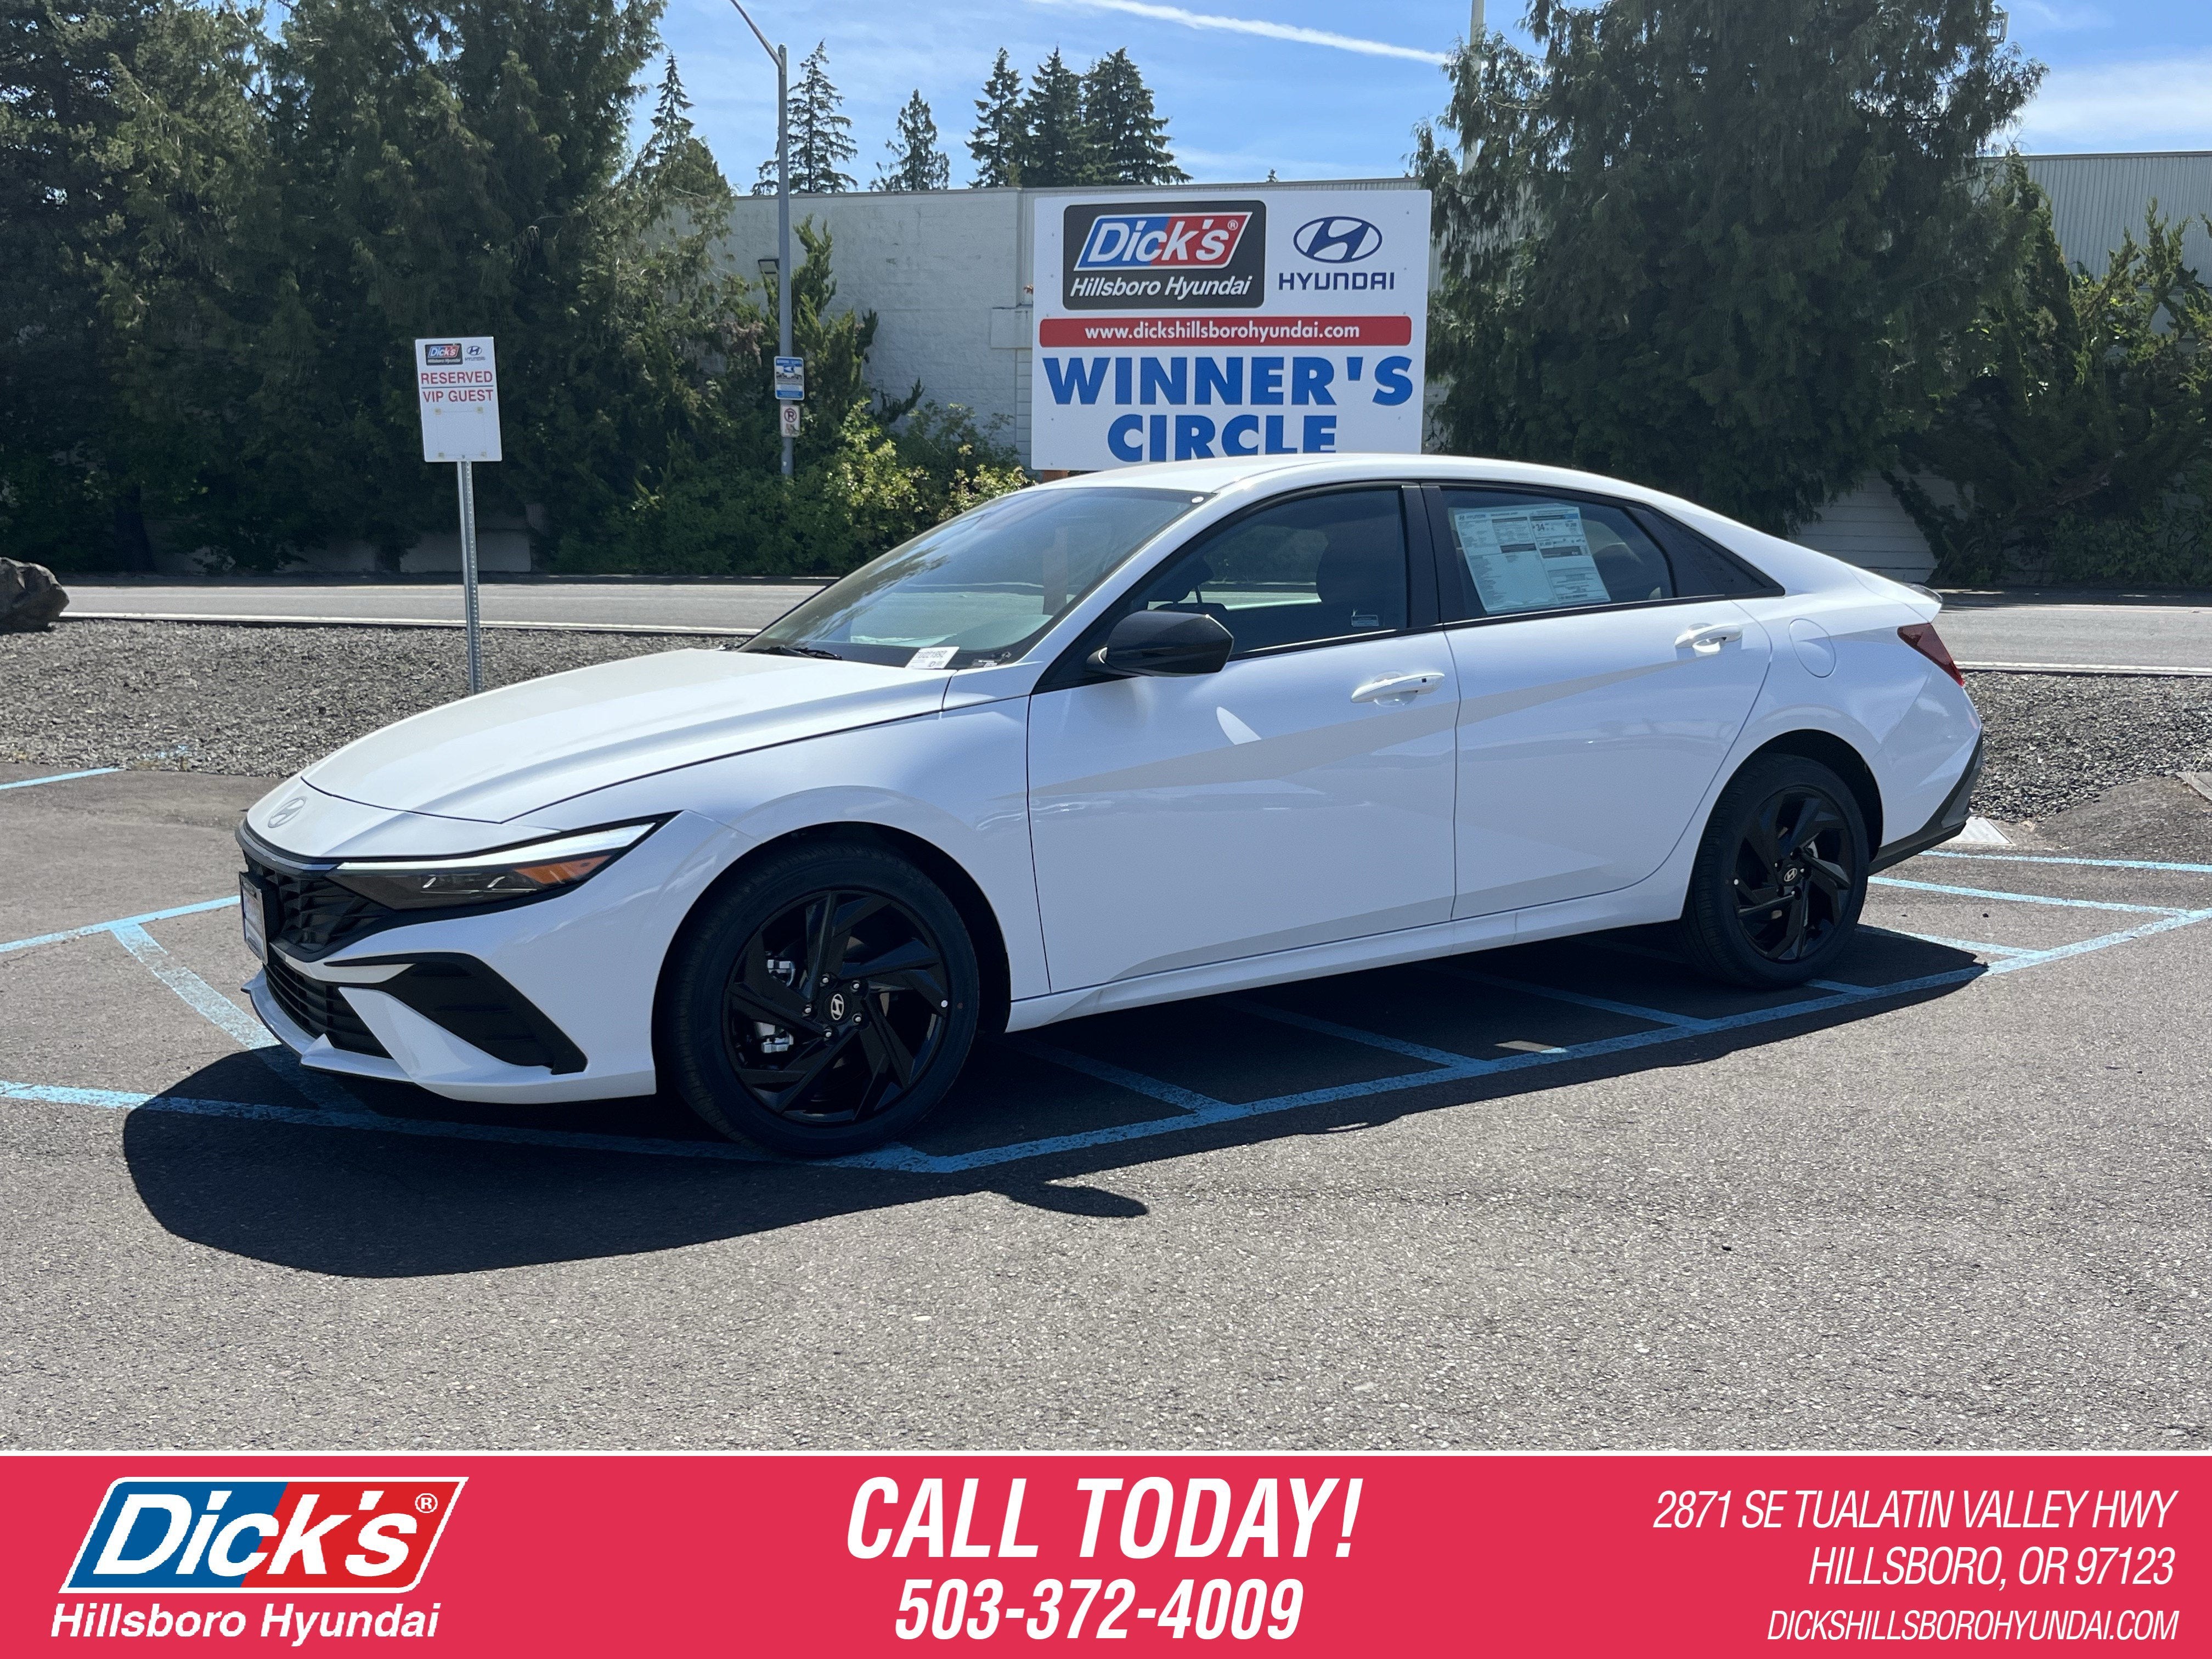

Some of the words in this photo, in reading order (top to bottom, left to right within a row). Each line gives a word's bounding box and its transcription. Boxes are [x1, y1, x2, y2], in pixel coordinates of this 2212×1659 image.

[1070, 278, 1161, 297] Hillsboro
[1165, 275, 1252, 301] Hyundai
[1279, 272, 1395, 290] HYUNDAI
[1085, 320, 1359, 343] www.dickshillsborohyundai.com
[421, 371, 493, 384] RESERVED
[1042, 356, 1413, 406] WINNER'S
[422, 391, 444, 403] VIP
[448, 390, 493, 402] GUEST
[1107, 414, 1337, 462] CIRCLE
